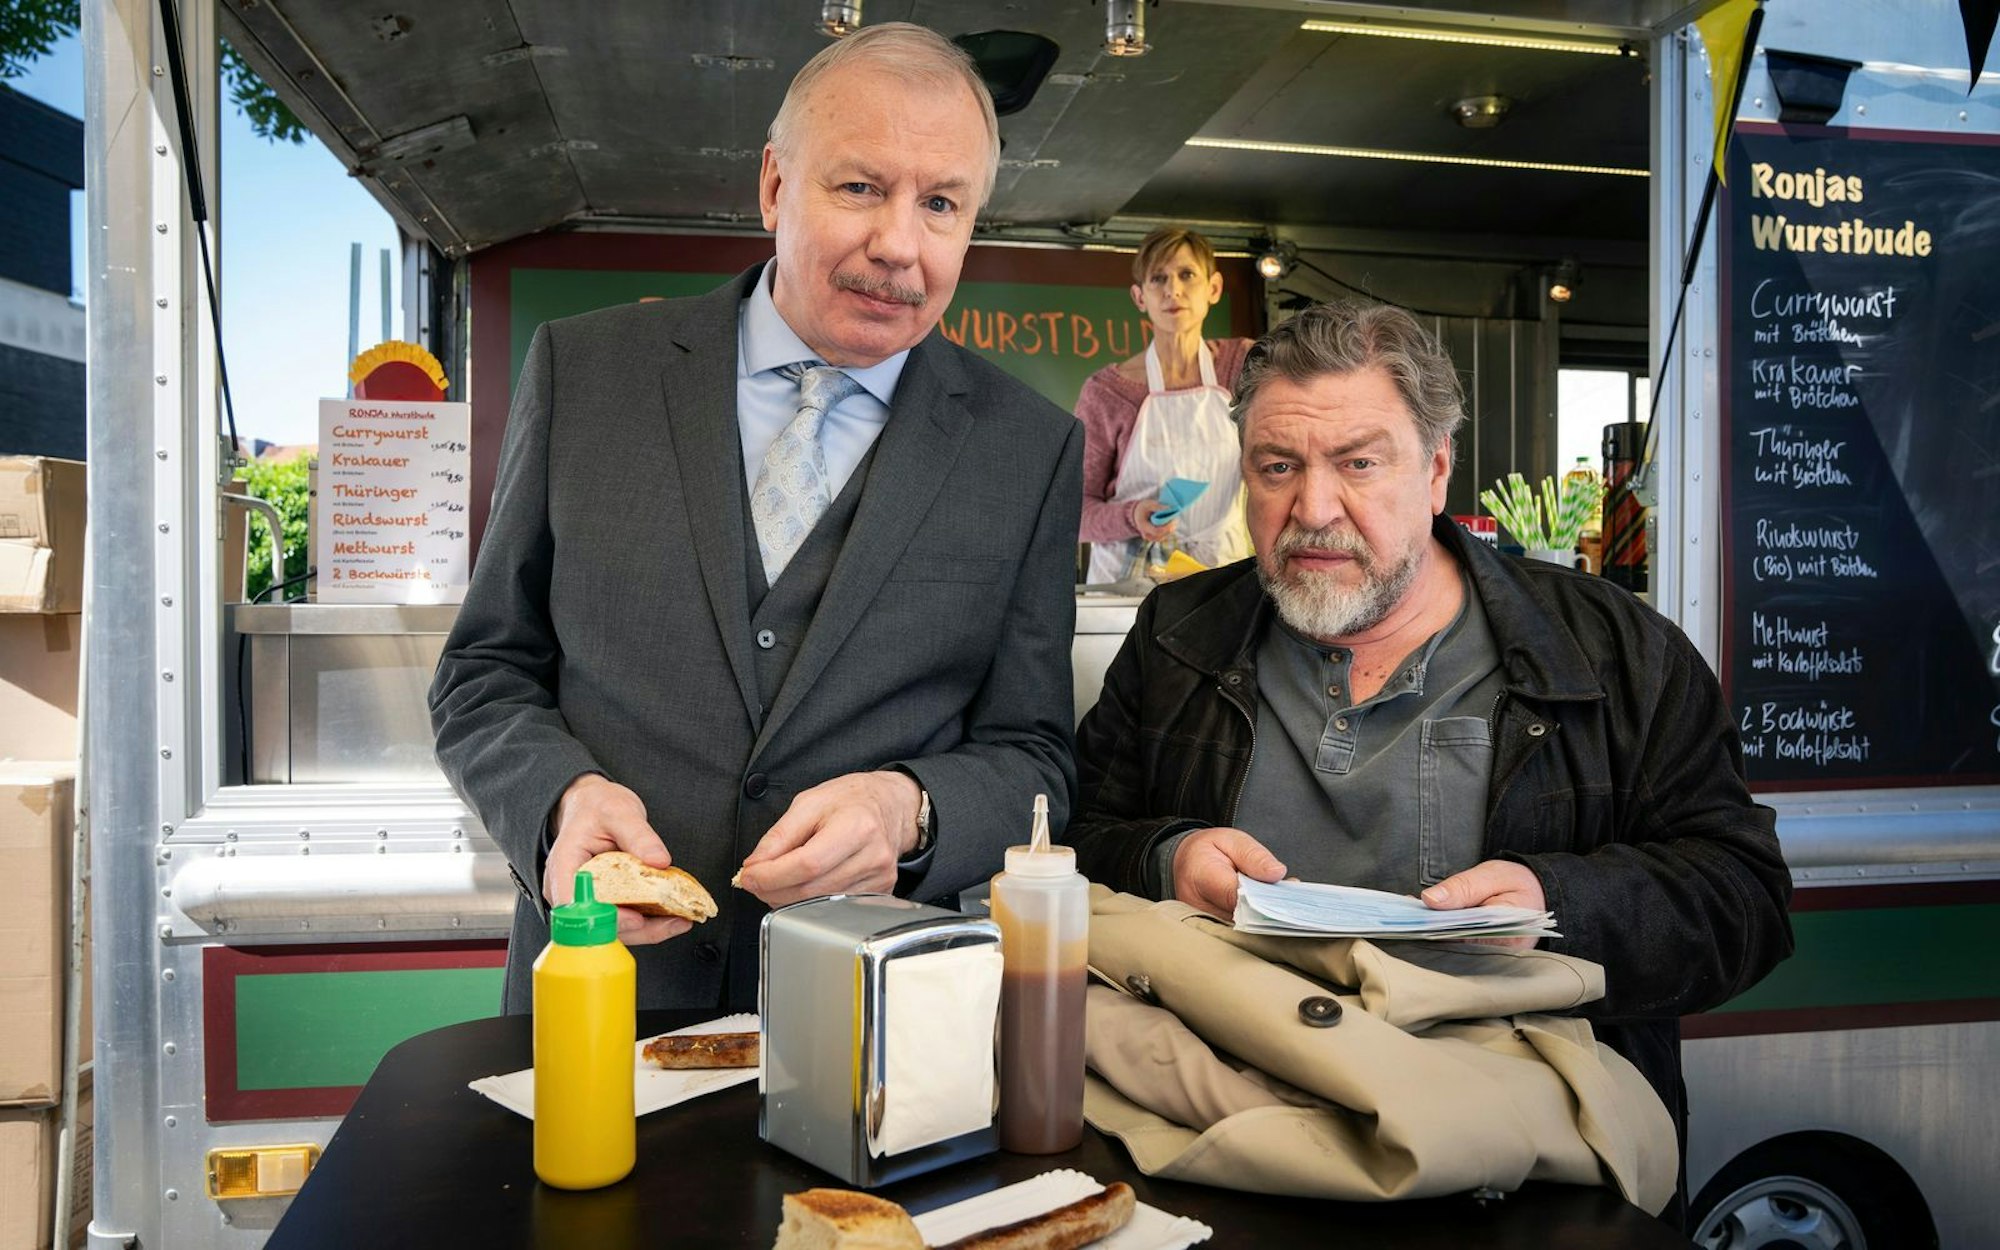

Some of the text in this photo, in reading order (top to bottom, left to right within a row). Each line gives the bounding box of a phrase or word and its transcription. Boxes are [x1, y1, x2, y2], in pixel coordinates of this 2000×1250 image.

[1752, 163, 1863, 207] Ronjas
[1752, 215, 1932, 257] Wurstbude
[1751, 279, 1896, 322] Currywurst
[1754, 324, 1780, 343] mit
[1752, 355, 1863, 385] Krakauer
[1754, 382, 1781, 403] mit
[332, 425, 429, 446] Currywurst
[1750, 424, 1846, 460] Thüringer
[332, 453, 410, 467] Krakauer
[1755, 461, 1788, 484] mit
[332, 484, 418, 502] Thüringer
[332, 511, 429, 527] Rindswurst
[333, 541, 416, 555] Mettwurst
[332, 567, 432, 580] 2 Bockwürste
[1753, 555, 1792, 581] (Bio)
[1796, 554, 1826, 576] mit
[1752, 652, 1773, 669] mit
[1742, 706, 1753, 731] 2
[1741, 736, 1765, 758] mit
